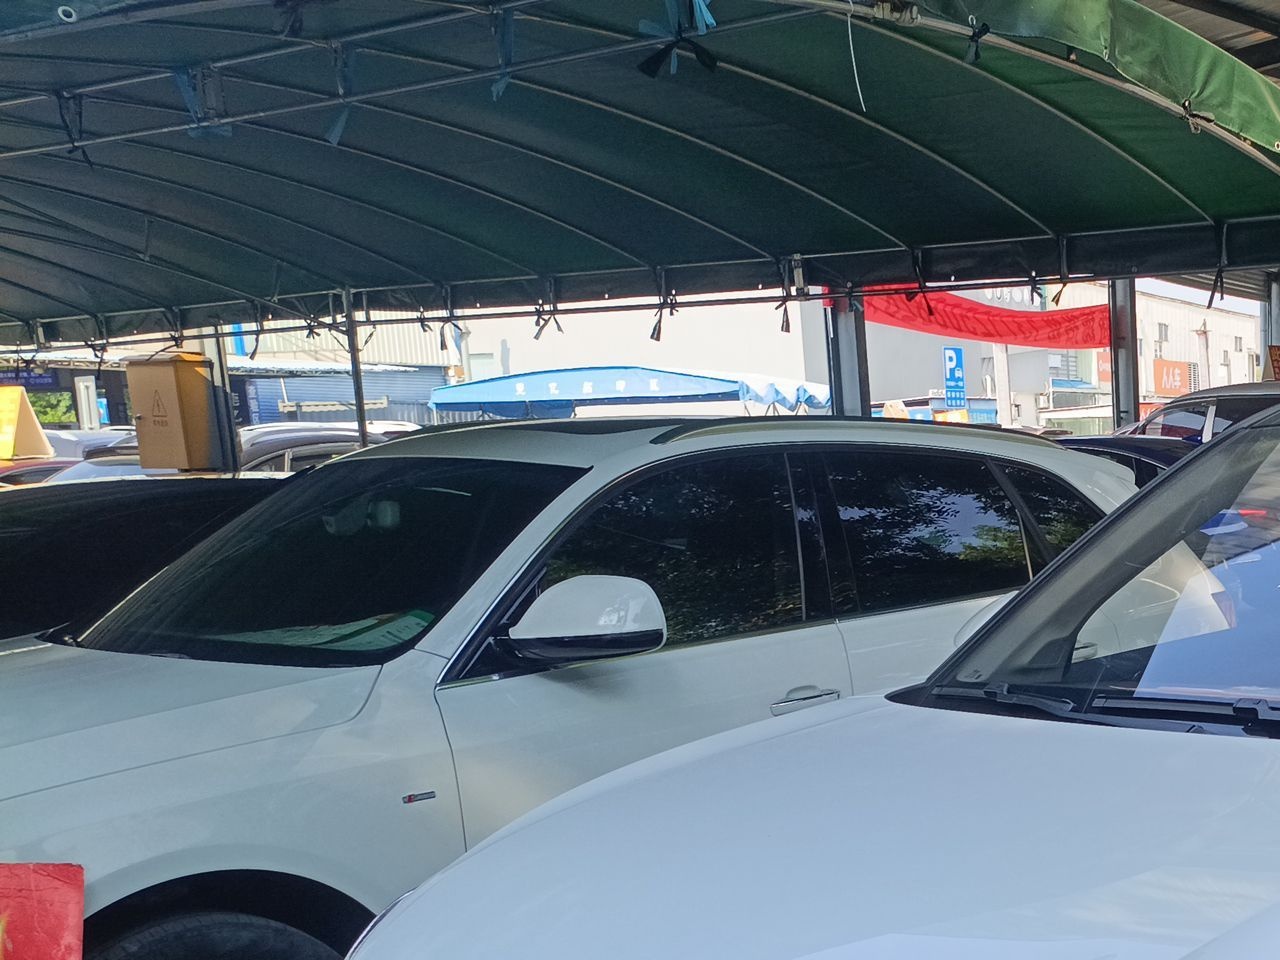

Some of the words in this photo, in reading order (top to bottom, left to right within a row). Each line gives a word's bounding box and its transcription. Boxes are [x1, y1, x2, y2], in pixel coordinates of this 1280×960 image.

[945, 349, 956, 378] P
[1162, 367, 1181, 389] 人人车
